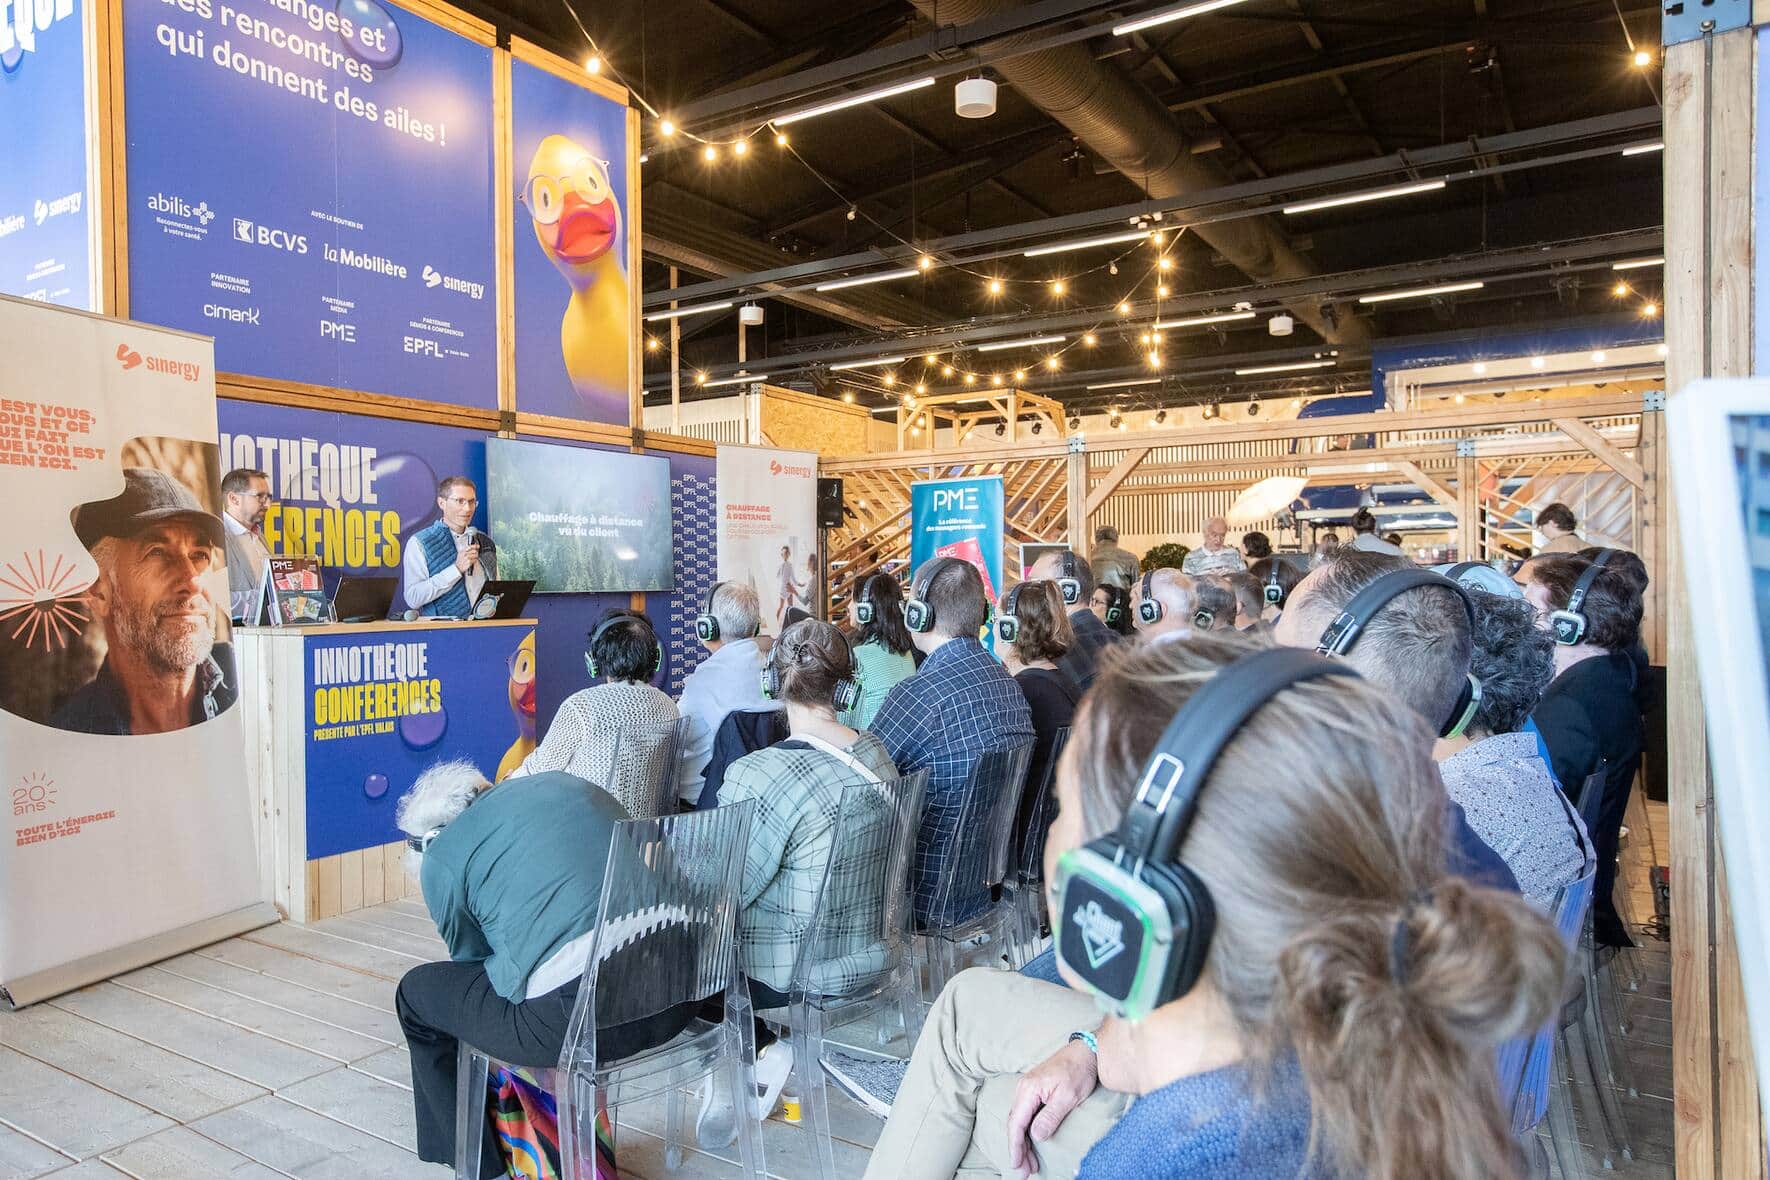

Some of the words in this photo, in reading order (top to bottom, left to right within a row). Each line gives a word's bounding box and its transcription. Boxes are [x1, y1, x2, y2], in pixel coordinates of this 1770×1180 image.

[159, 0, 213, 19] es
[221, 5, 373, 84] rencontres
[360, 27, 386, 52] et
[156, 24, 204, 58] qui
[213, 40, 328, 104] donnent
[334, 87, 378, 122] des
[384, 107, 435, 142] ailes
[439, 123, 446, 146] !
[148, 193, 192, 218] abilis
[311, 211, 326, 219] AVEC
[333, 217, 356, 228] SOUTIEN
[357, 222, 364, 230] DE
[257, 226, 308, 254] BCVS
[324, 244, 338, 262] la
[340, 248, 407, 279] Mobilière
[211, 272, 250, 286] PARTENAIRE
[211, 281, 251, 294] INNOVATION
[443, 276, 485, 300] sinergy
[322, 296, 354, 308] PARTENAIRE
[203, 304, 260, 325] cimark
[320, 320, 356, 343] PME
[403, 336, 444, 358] EPFL
[146, 356, 200, 382] sinergy
[40, 404, 96, 424] VOUS,
[40, 417, 62, 430] ET
[66, 421, 90, 434] CE
[25, 430, 69, 444] FAIT
[28, 443, 70, 457] L'ON
[73, 447, 106, 460] EST
[39, 456, 79, 470] ICI.
[726, 504, 770, 512] CHAUFFAGE
[933, 488, 979, 512] PME
[529, 512, 588, 527] Chauffage
[590, 514, 597, 525] à
[598, 515, 644, 527] distance
[733, 513, 772, 521] DISTANCE
[588, 527, 619, 537] client
[272, 561, 294, 570] PME
[315, 678, 442, 725] CONFÉRENCES
[13, 785, 46, 805] 20
[14, 801, 46, 816] ans
[16, 823, 54, 838] TOUTE
[56, 810, 116, 829] L'ÉNERGIE
[16, 833, 46, 847] BIEN
[49, 826, 81, 840] D'ICI
